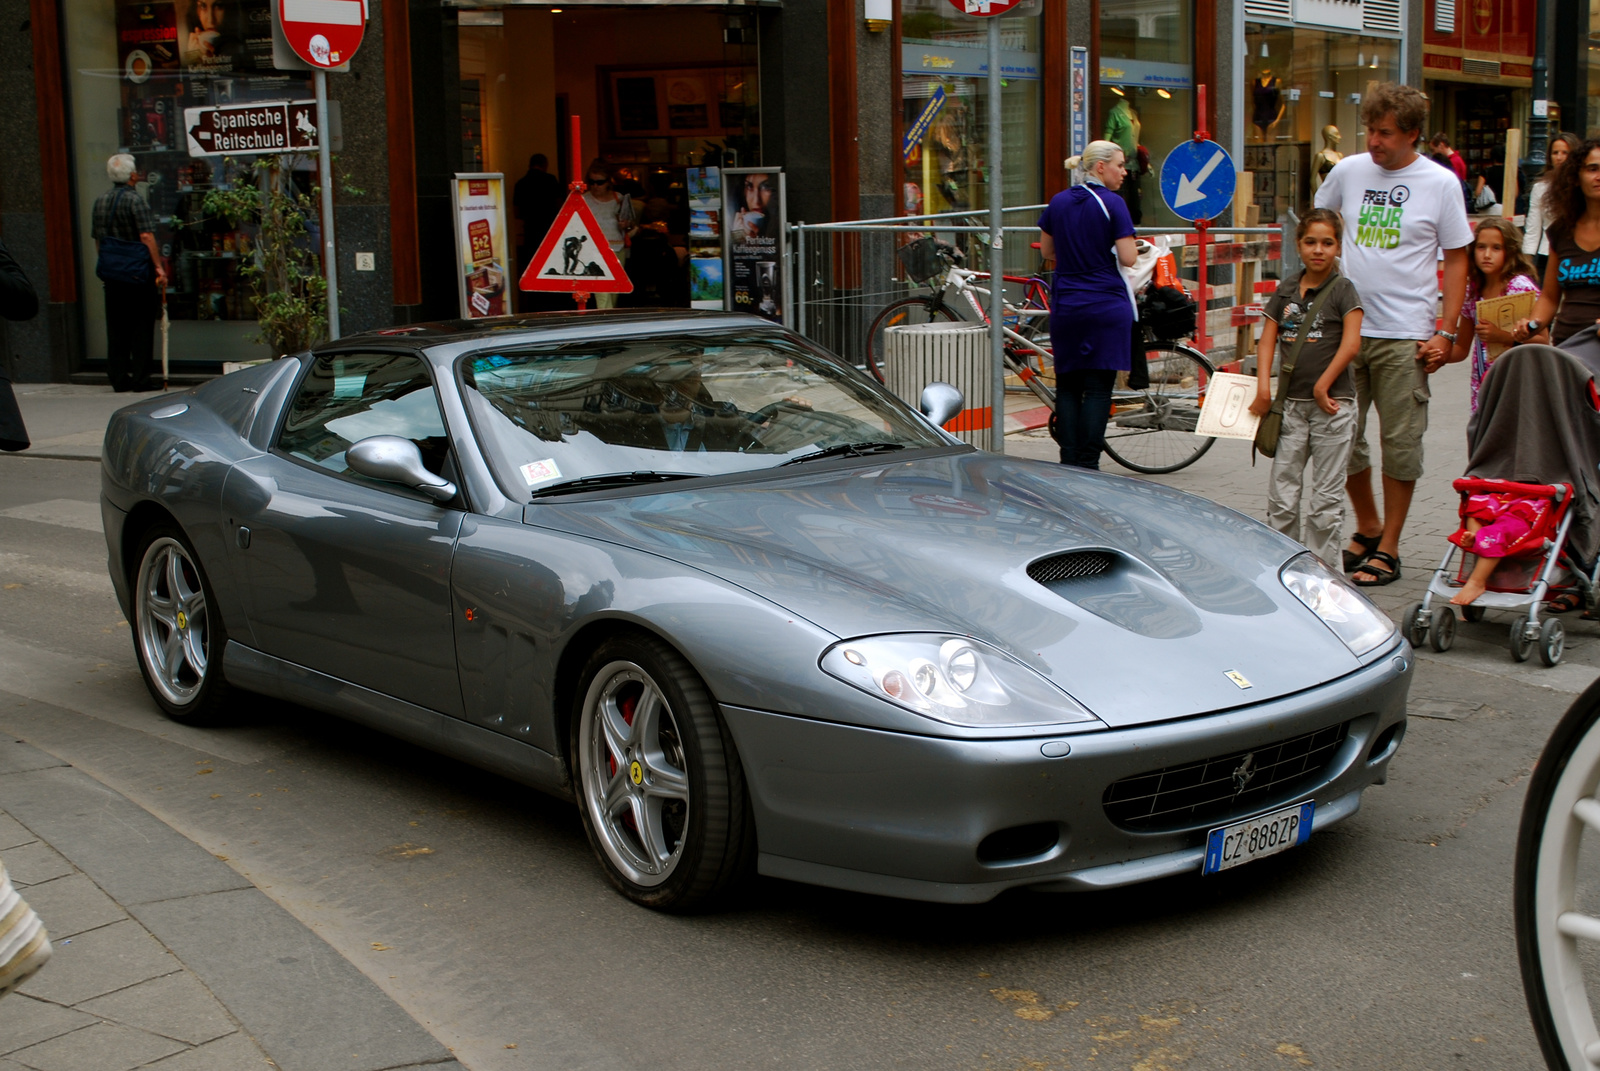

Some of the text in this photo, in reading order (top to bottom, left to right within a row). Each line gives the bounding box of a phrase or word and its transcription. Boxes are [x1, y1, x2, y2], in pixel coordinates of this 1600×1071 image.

[212, 109, 282, 133] Spanische
[214, 130, 284, 150] Reitschule
[1362, 189, 1388, 206] FREE
[1358, 205, 1404, 228] YOUR
[472, 234, 490, 250] 5+2
[746, 236, 776, 245] Perfekter
[1355, 226, 1401, 249] MIND
[733, 244, 777, 256] Kaffeegenuss
[1223, 815, 1299, 862] CZ 888ZP
